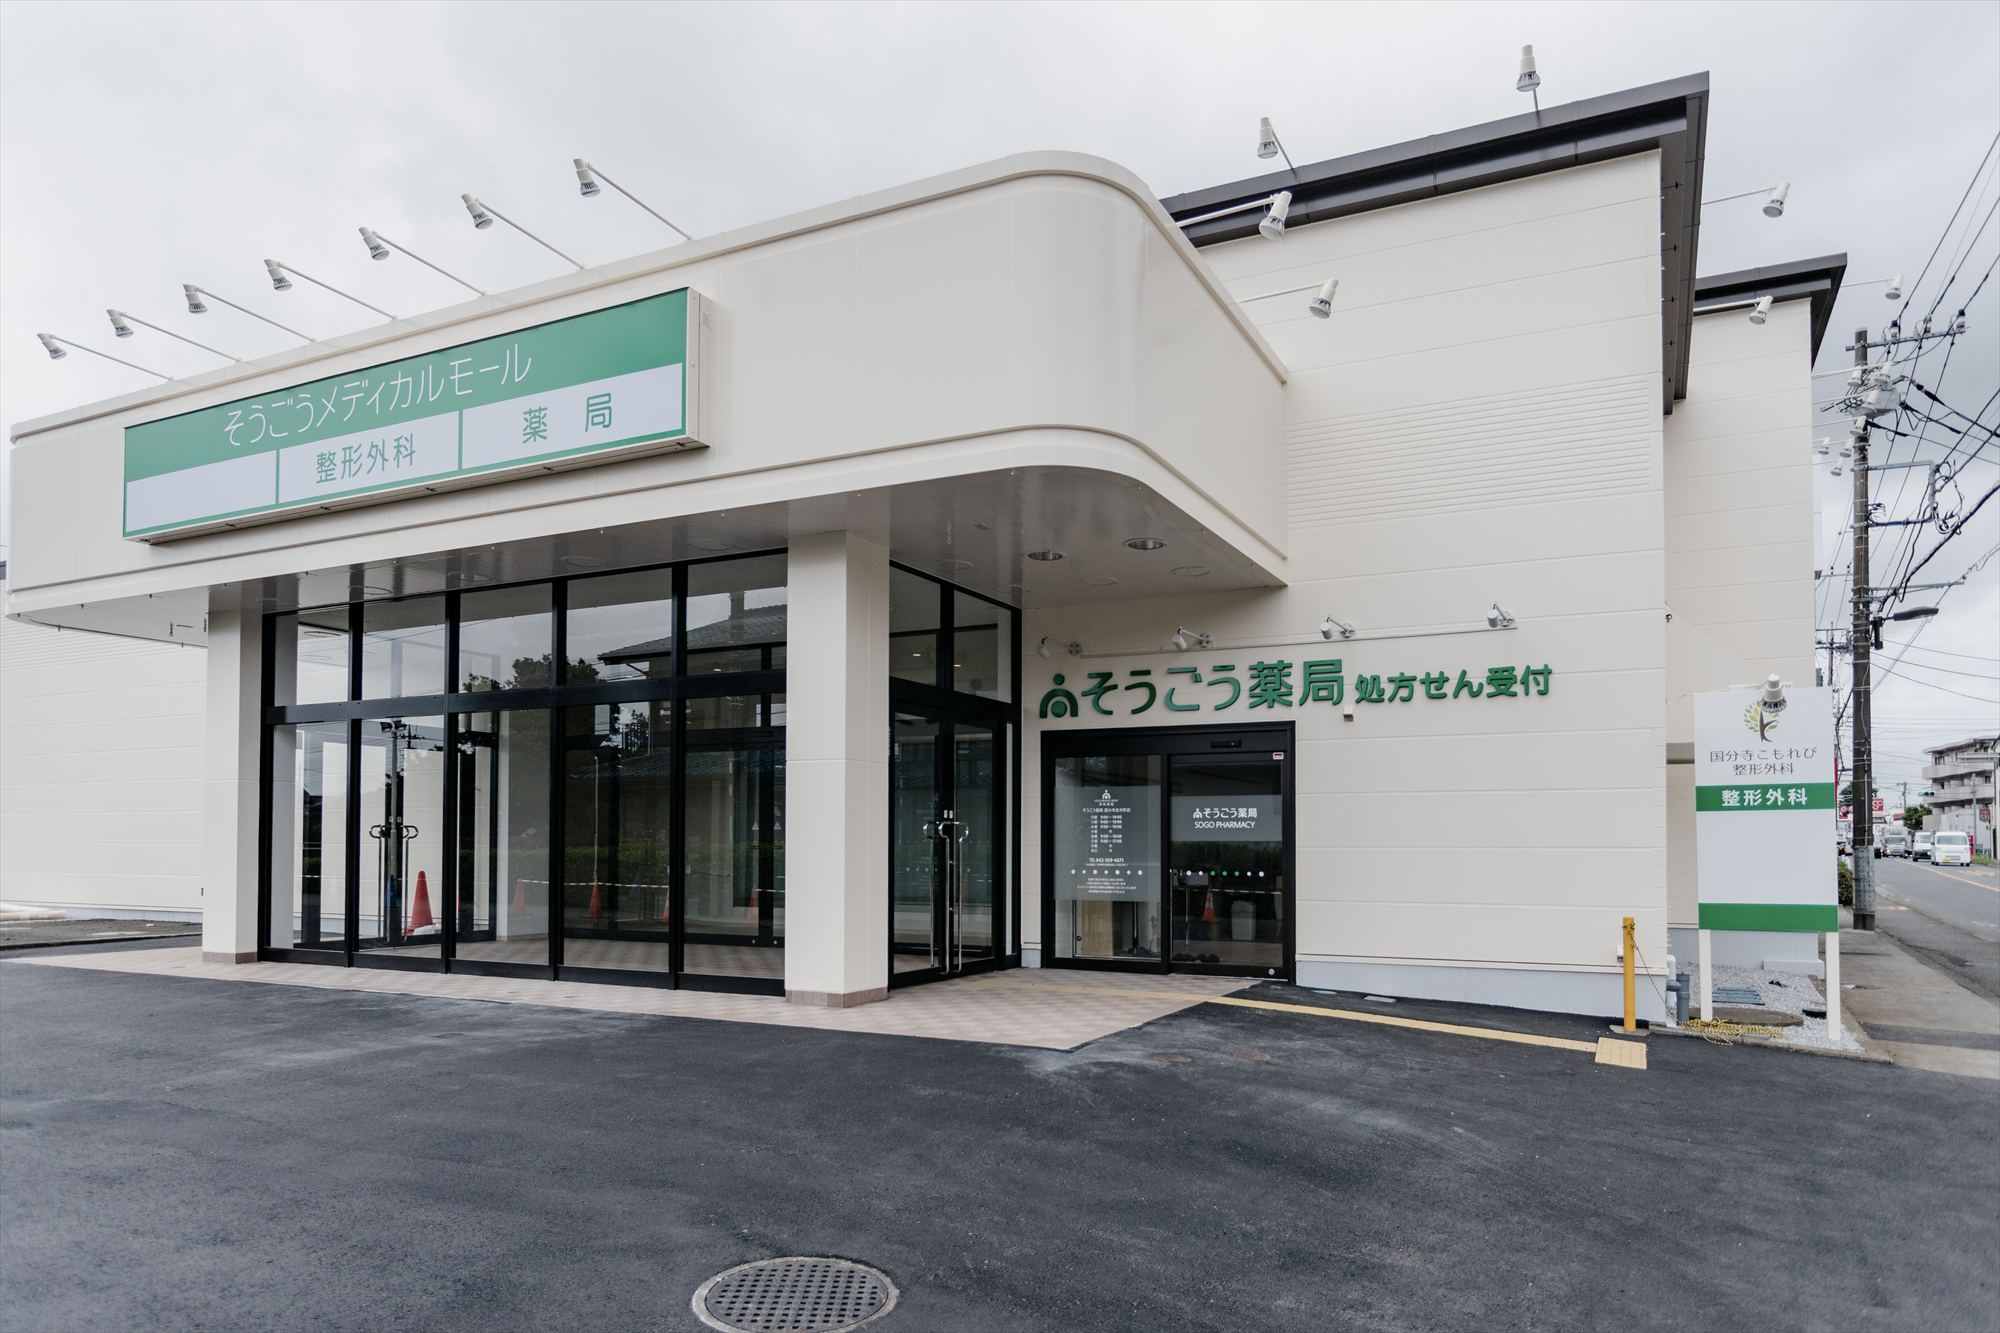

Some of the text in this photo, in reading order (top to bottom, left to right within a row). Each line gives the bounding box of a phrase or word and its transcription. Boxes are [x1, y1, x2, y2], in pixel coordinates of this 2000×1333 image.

[223, 343, 532, 447] そうごうメディカルモール
[315, 432, 416, 485] 整形外科
[1081, 658, 1553, 716] そうごう薬局 処方せん受付
[1710, 747, 1817, 762] 国分寺こもれび
[1733, 762, 1794, 776] 整形外科
[1721, 787, 1808, 807] 整形外科
[1203, 808, 1258, 818] そうごう薬局
[1216, 820, 1256, 828] PHARMACY
